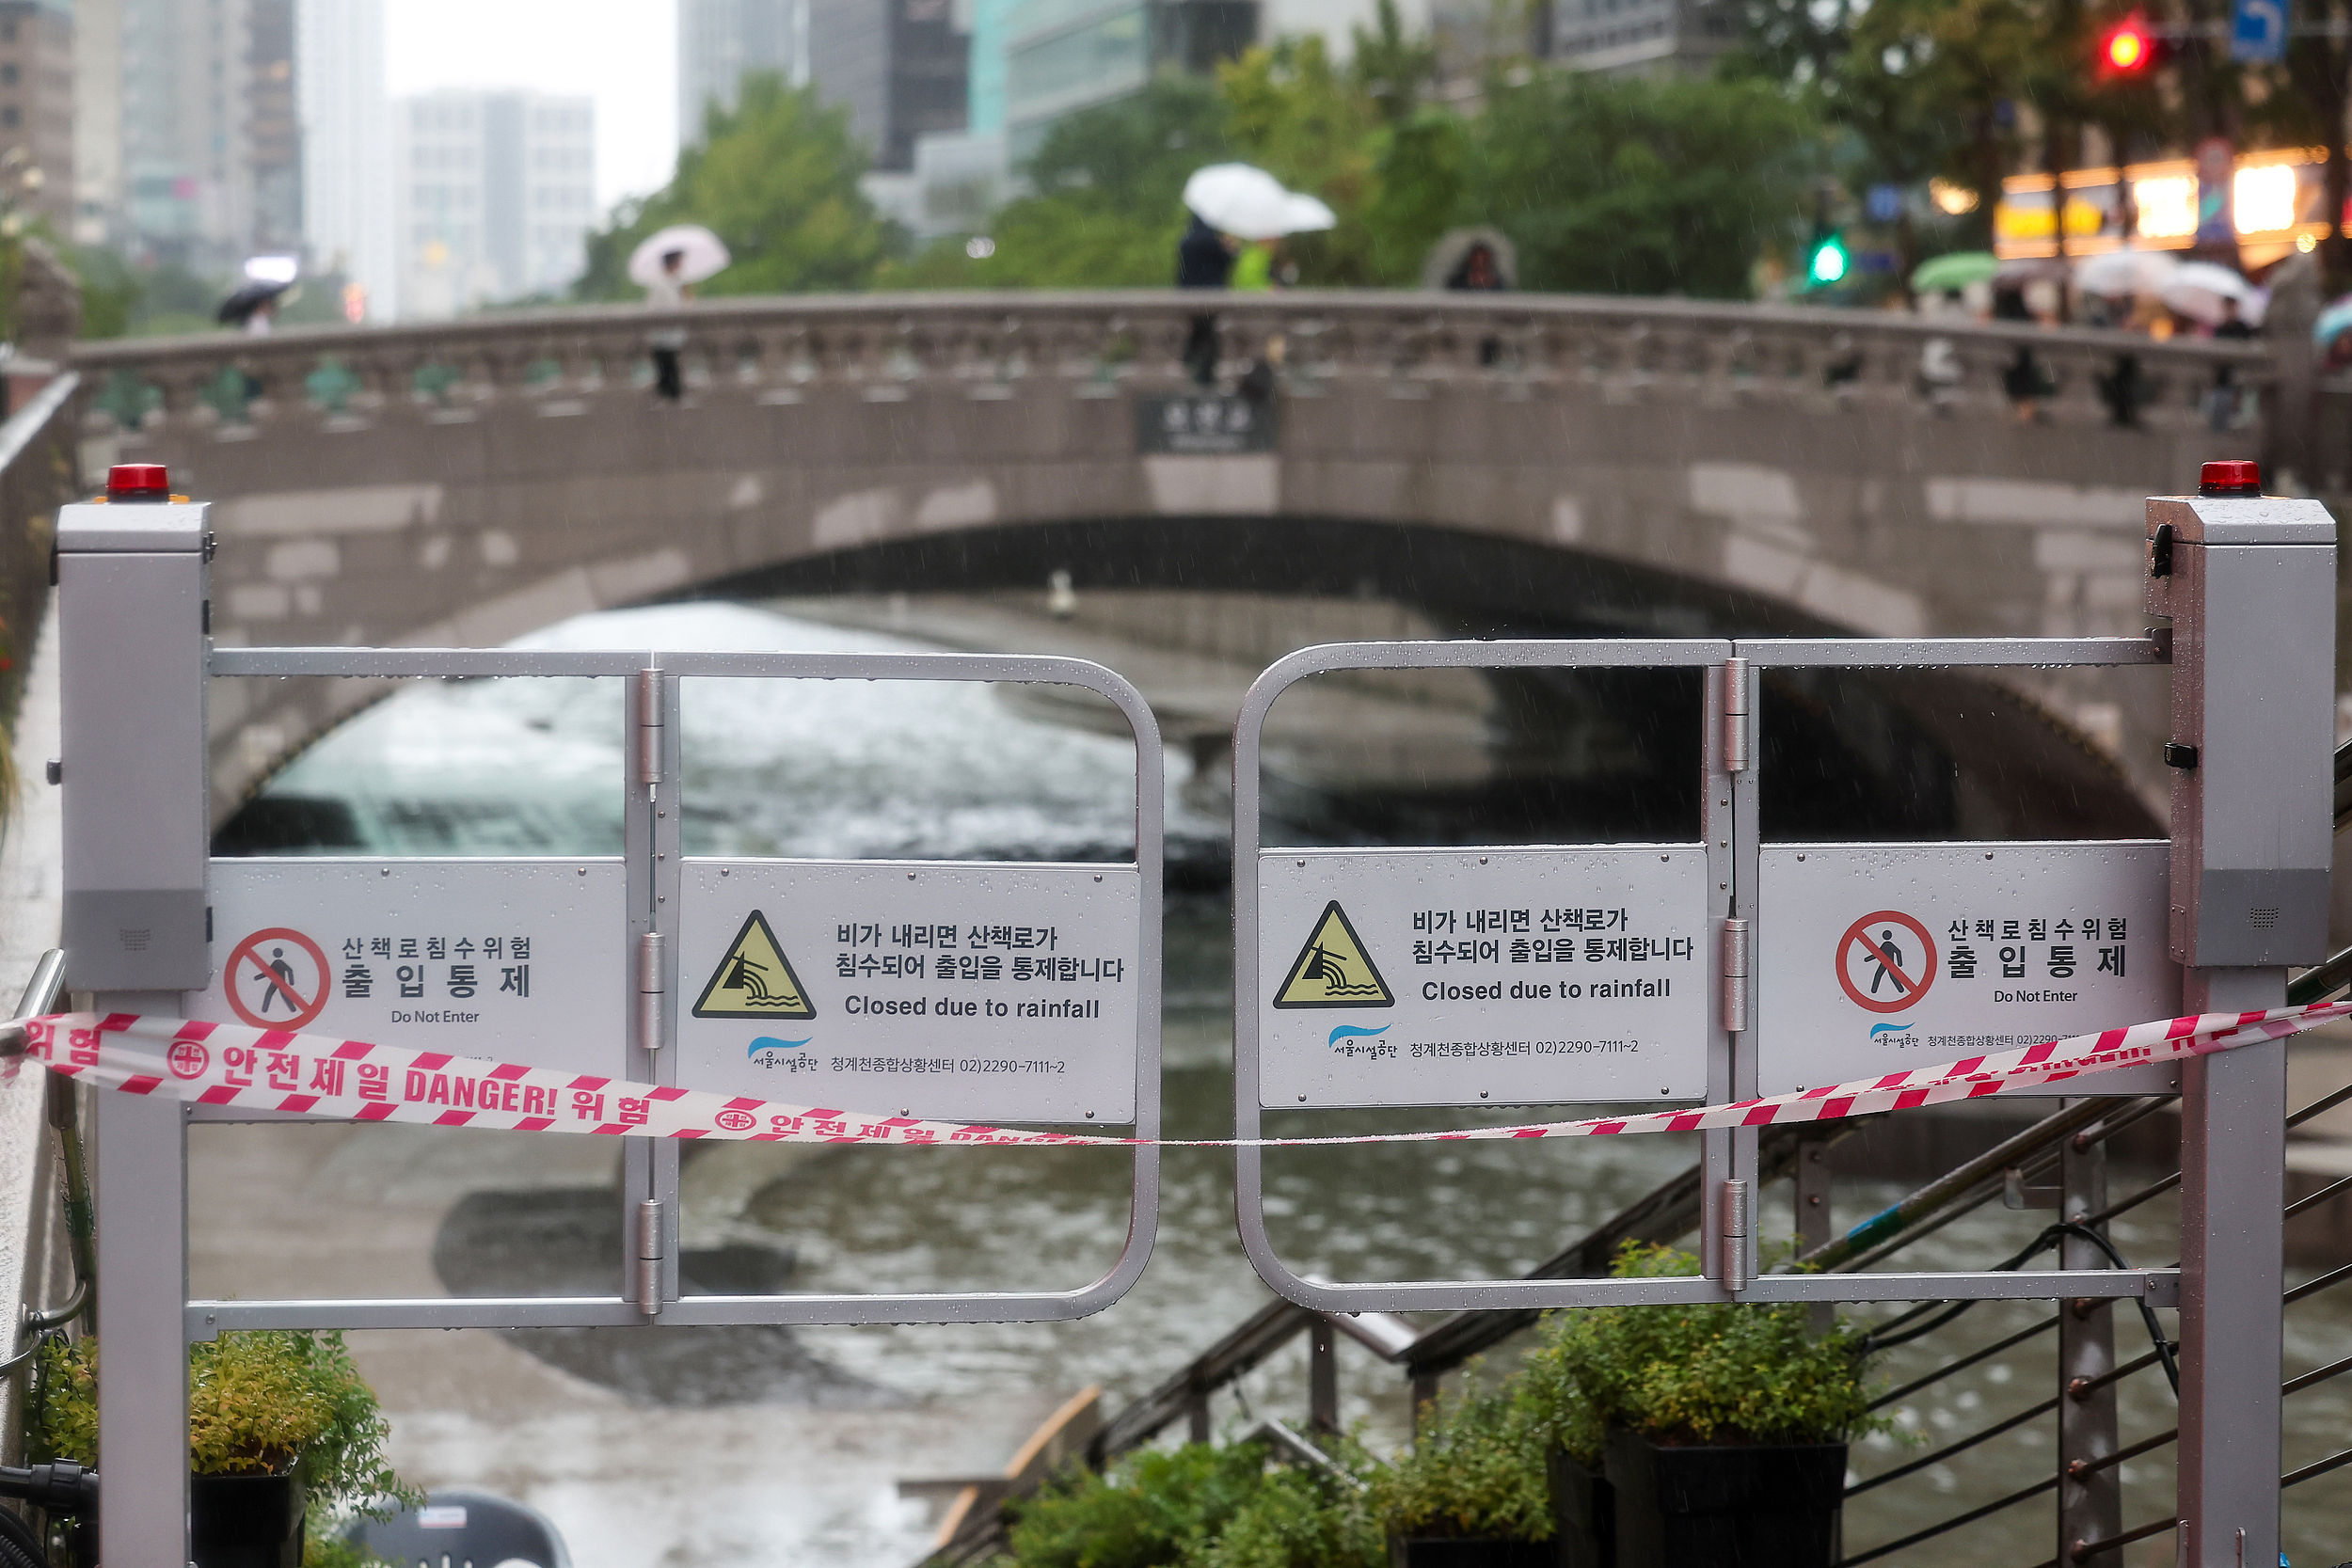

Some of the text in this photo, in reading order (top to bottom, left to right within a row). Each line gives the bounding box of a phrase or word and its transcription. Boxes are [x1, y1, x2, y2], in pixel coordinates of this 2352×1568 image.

[1413, 907, 1629, 935] 비가 내리면 산책로가
[1947, 917, 2127, 942] 산책로침수위험
[342, 936, 530, 960] 산책로침수위험
[837, 923, 1058, 951] 비가 내리면 산책로가
[1412, 936, 1694, 965] 침수되어 출입을 통제합니다
[835, 953, 1124, 983] 침수되어 출입을 통제합니다
[1422, 978, 1670, 1001] Closed due to rainfall
[1994, 990, 2078, 1003] Do Not Enter
[391, 1010, 480, 1023] Do Not Enter
[845, 995, 1099, 1019] Closed due to rainfall
[25, 1021, 103, 1067] 위험
[1334, 1038, 1398, 1061] 서울시설공단
[1409, 1040, 1531, 1058] 청계천종합상황센터
[1873, 1033, 1919, 1049] 서울시설공단
[1928, 1035, 2013, 1047] 청계천종합상황센터
[754, 1051, 818, 1073] 서울시설공단
[831, 1056, 954, 1073] 청계천종합상황센터
[222, 1045, 389, 1102] 안전제일
[404, 1069, 558, 1117] DANGER!
[570, 1089, 651, 1127] 위험
